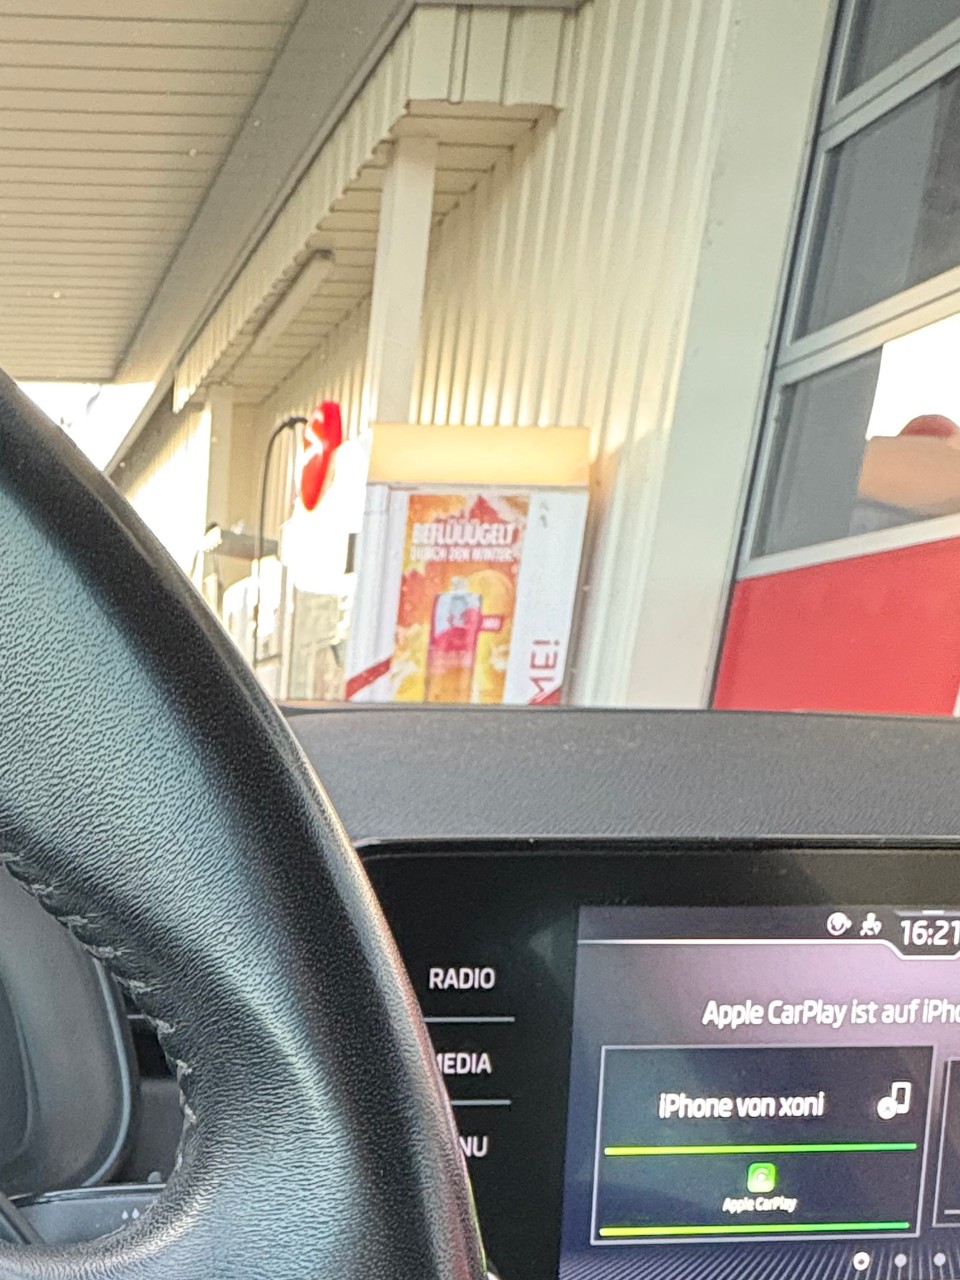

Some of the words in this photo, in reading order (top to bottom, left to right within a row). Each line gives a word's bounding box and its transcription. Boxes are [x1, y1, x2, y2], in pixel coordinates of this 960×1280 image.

[900, 920, 960, 946] 16:21
[429, 967, 496, 990] RADIO
[702, 1000, 764, 1029] Apple
[768, 999, 847, 1028] CarPlay
[851, 999, 878, 1024] ist
[881, 999, 920, 1024] auf
[658, 1092, 733, 1118] iPhone
[735, 1096, 775, 1117] von
[779, 1091, 825, 1117] xoni
[459, 1136, 488, 1158] NU
[722, 1197, 754, 1214] Apple
[756, 1196, 797, 1213] CarPlay
